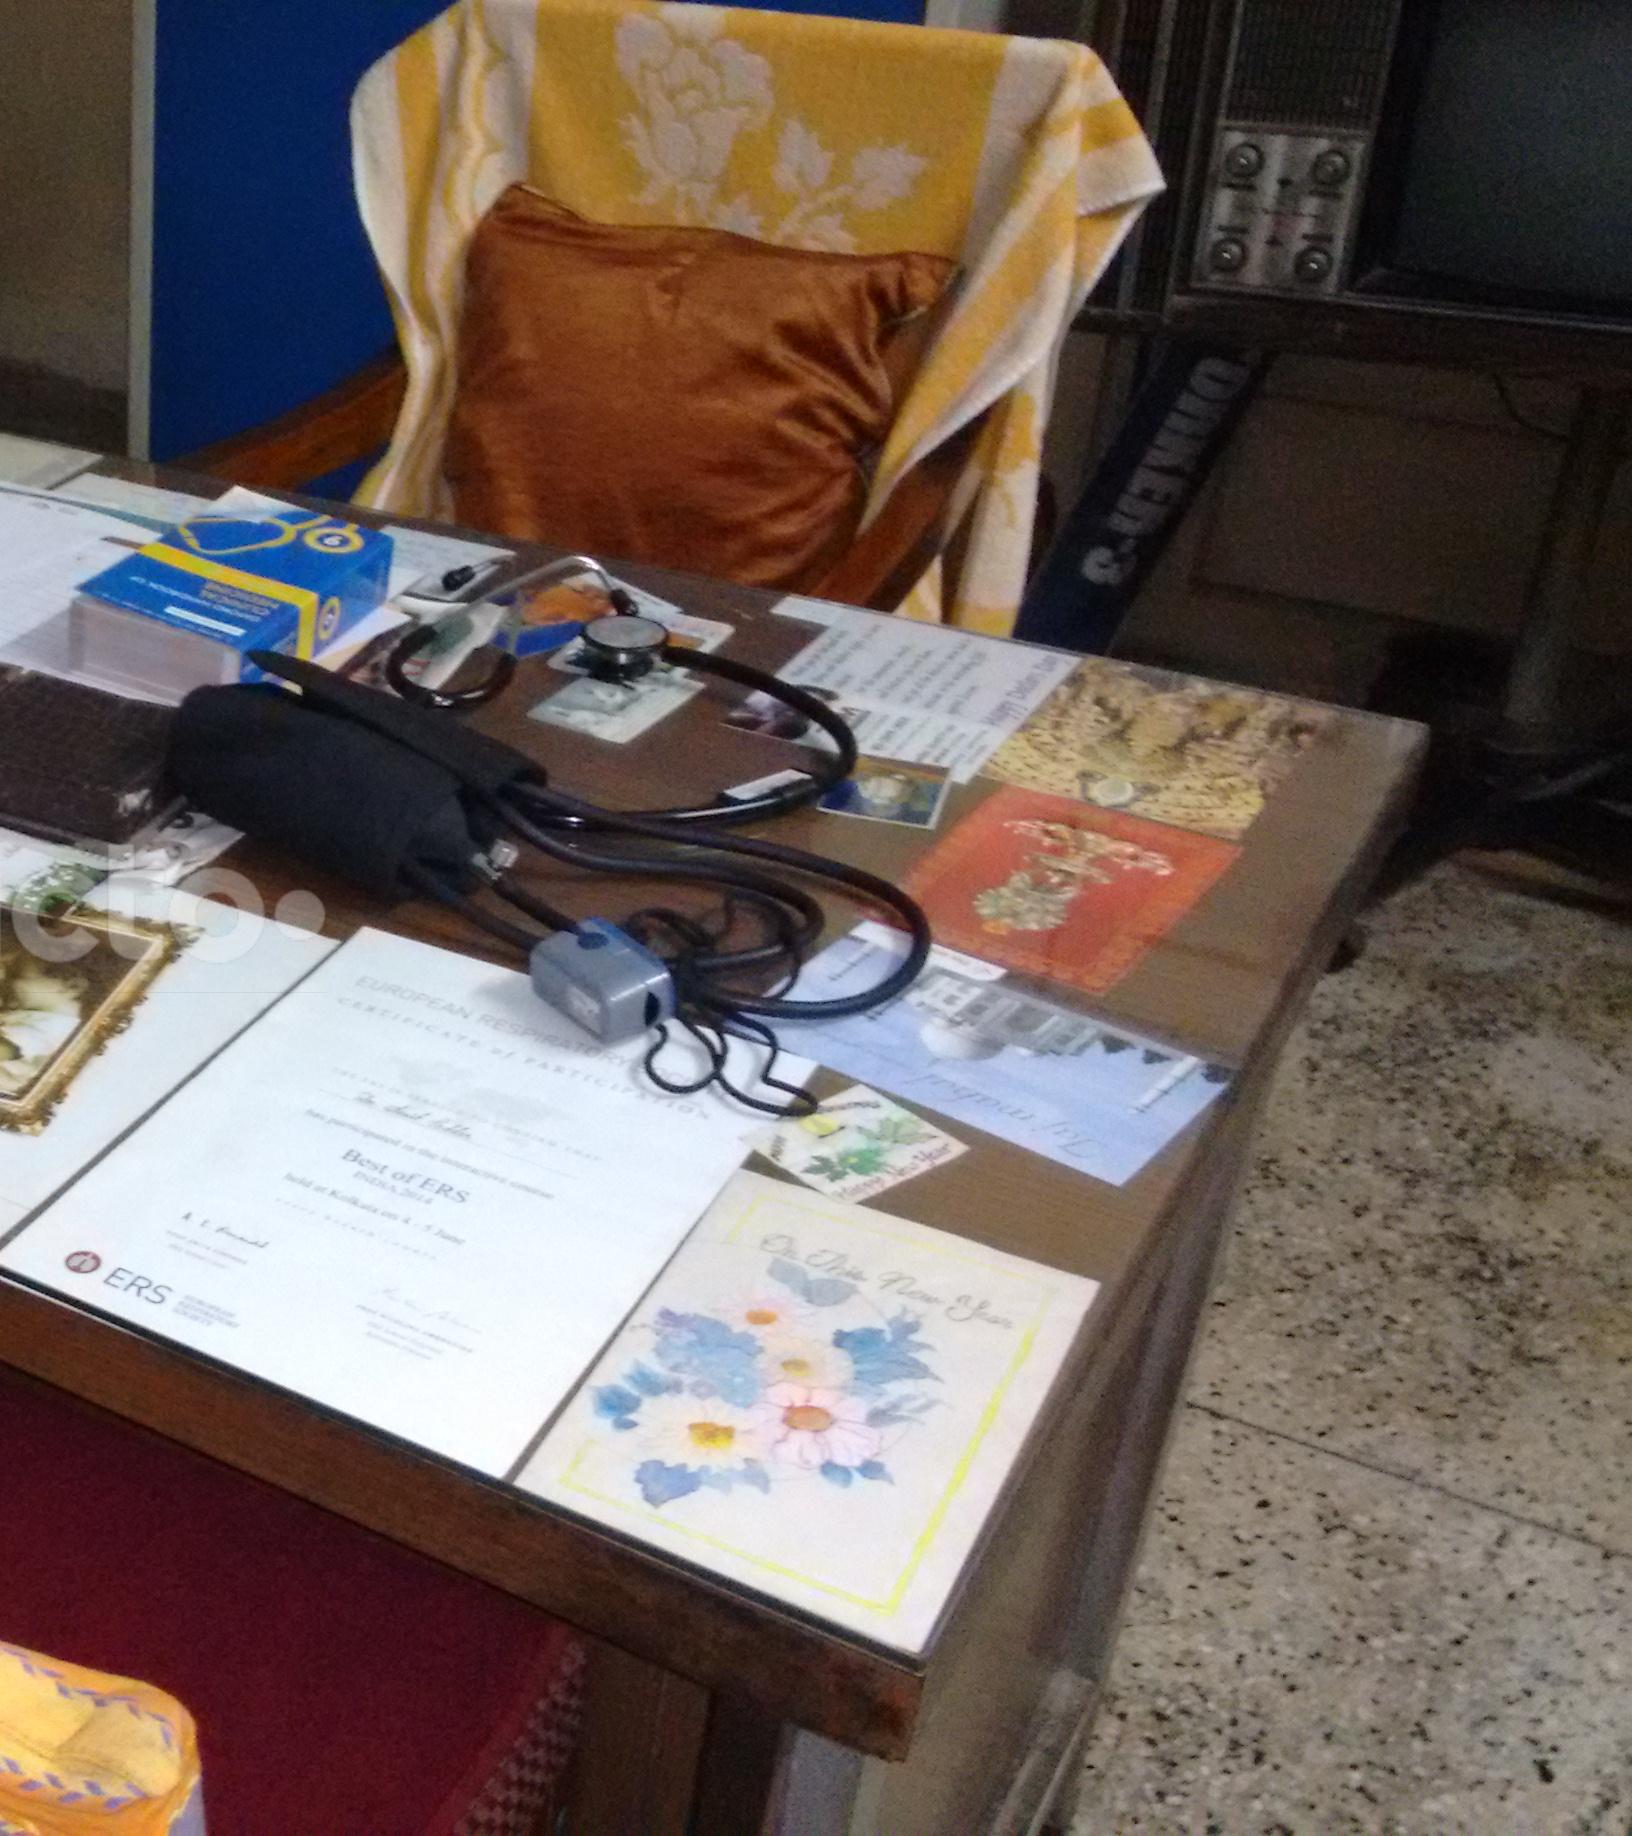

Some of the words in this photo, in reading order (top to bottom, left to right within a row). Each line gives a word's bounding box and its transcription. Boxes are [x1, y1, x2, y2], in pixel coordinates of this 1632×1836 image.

[332, 996, 485, 1049] CERTIFICATE
[352, 975, 475, 1018] EUROPEAN
[342, 1148, 388, 1174] Best
[391, 1171, 422, 1184] of
[419, 1177, 470, 1203] ERS
[101, 1264, 177, 1307] ERS
[879, 1270, 945, 1305] New
[945, 1294, 1014, 1330] Year
